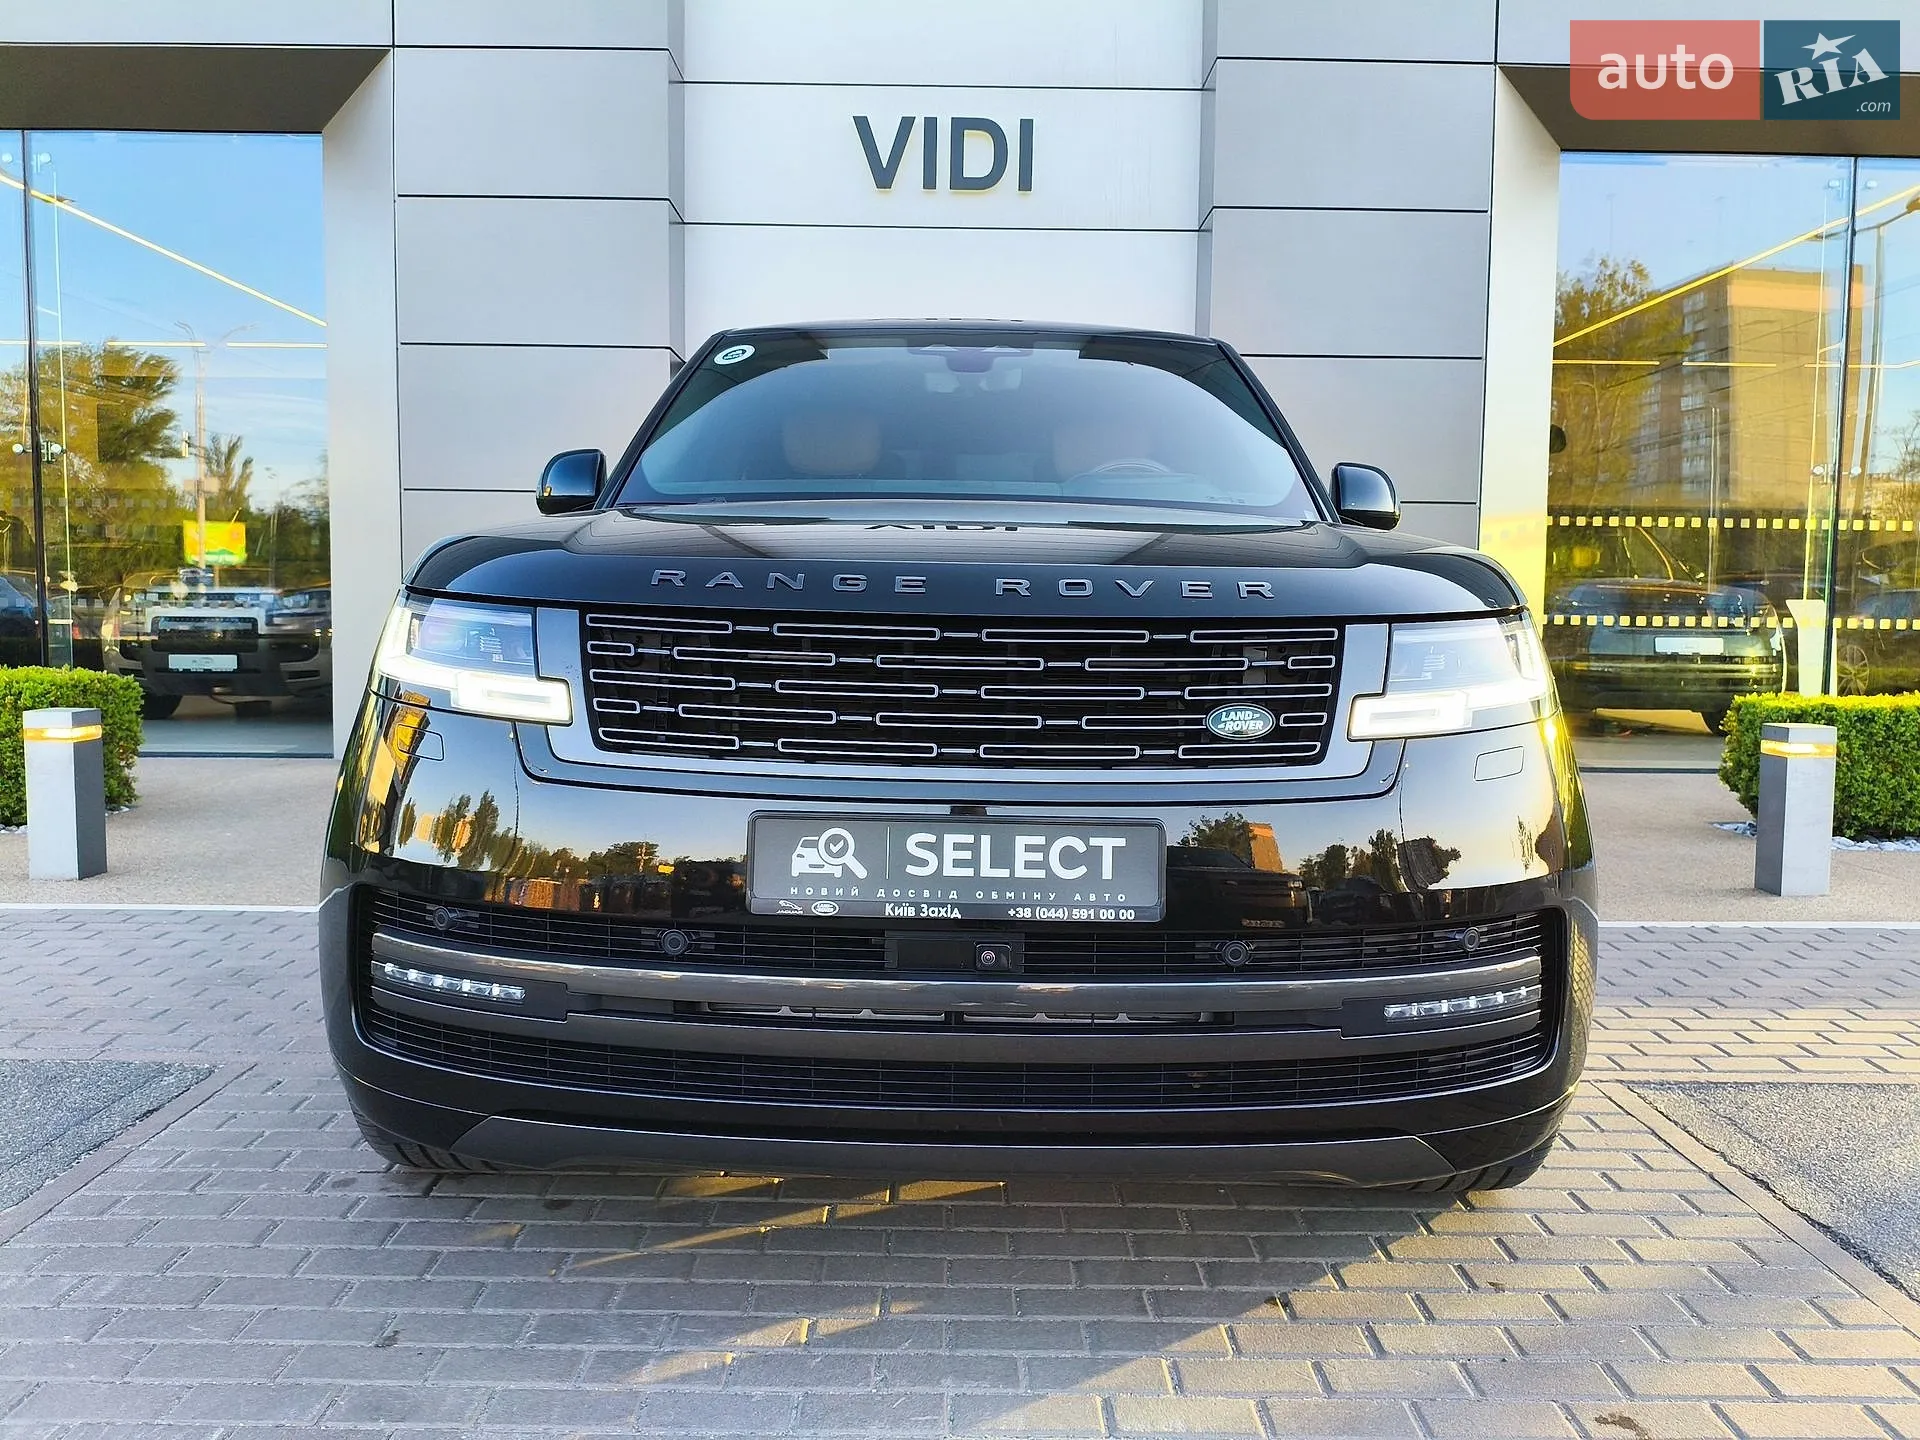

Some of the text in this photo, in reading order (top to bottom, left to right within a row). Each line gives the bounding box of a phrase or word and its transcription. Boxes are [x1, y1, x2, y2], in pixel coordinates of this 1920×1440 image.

[852, 115, 1034, 192] VIDI
[650, 569, 1275, 600] RANGE ROVER
[1220, 710, 1254, 722] LAND
[1224, 720, 1264, 731] ROVER
[904, 832, 1128, 880] SELECT
[790, 886, 1127, 903] НОВИЙ ДОСВІД ОБМІНУ АВТО
[885, 903, 962, 919] Київ Захід
[1007, 906, 1136, 921] +38 (044) 591 00 00
